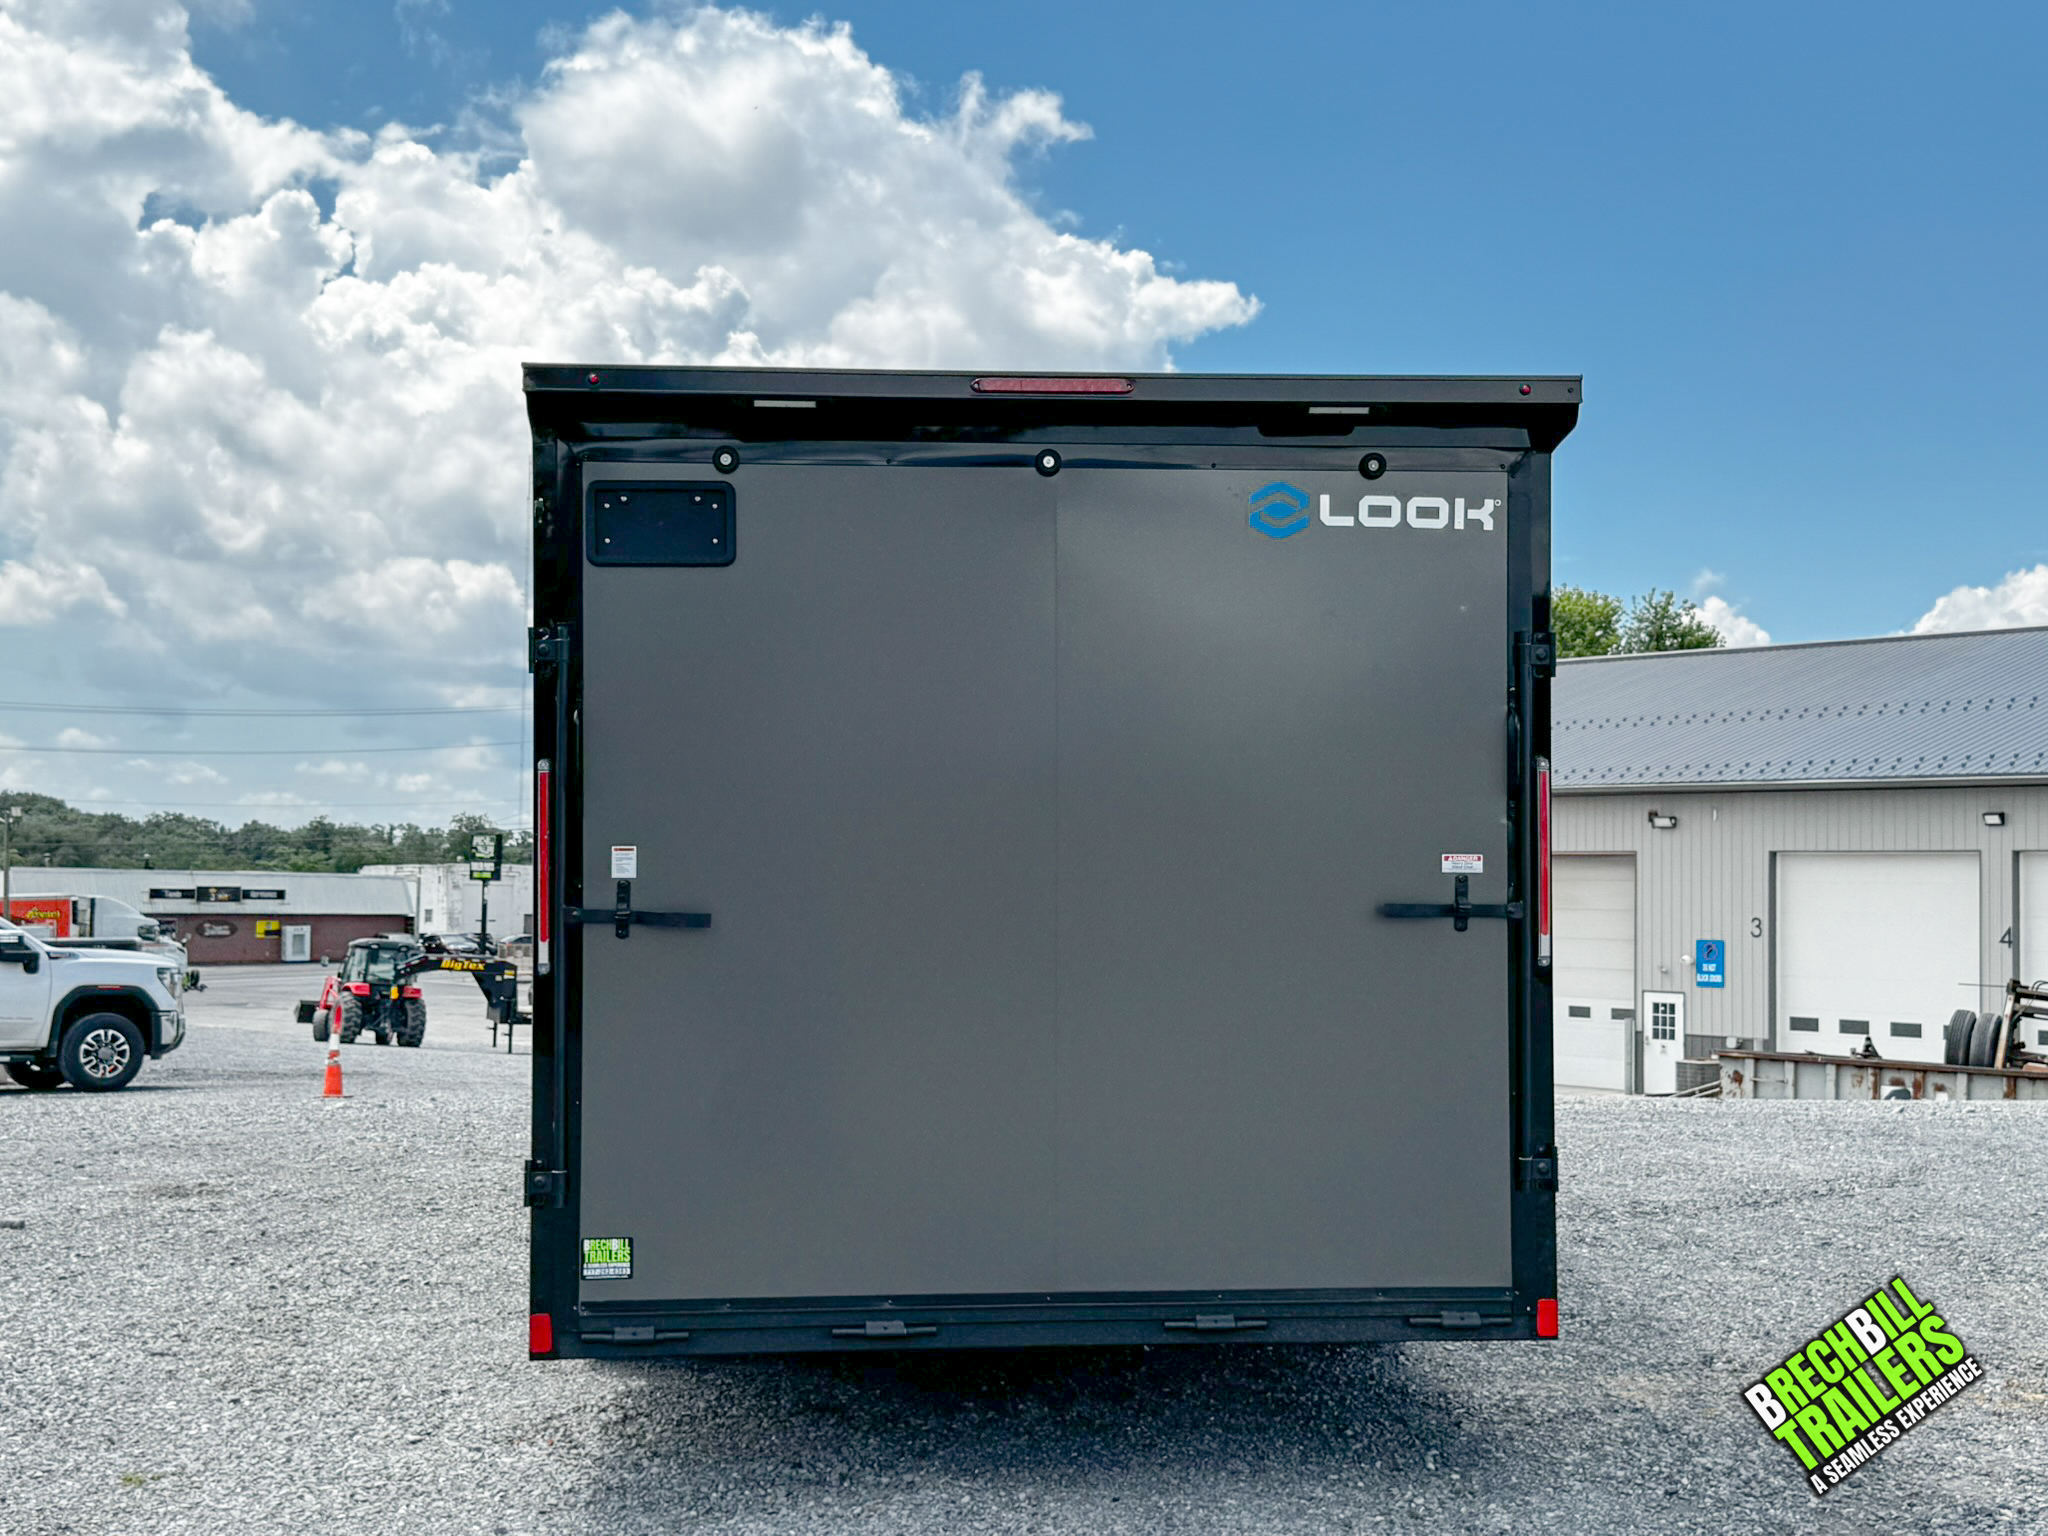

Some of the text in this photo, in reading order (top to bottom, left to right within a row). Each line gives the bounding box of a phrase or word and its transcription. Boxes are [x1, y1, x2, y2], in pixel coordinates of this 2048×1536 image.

[1319, 494, 1495, 531] LOOK
[1750, 917, 1763, 938] 3
[1999, 926, 2013, 948] 4
[583, 1238, 631, 1251] BRECHBILL
[584, 1250, 631, 1264] TRAILERS
